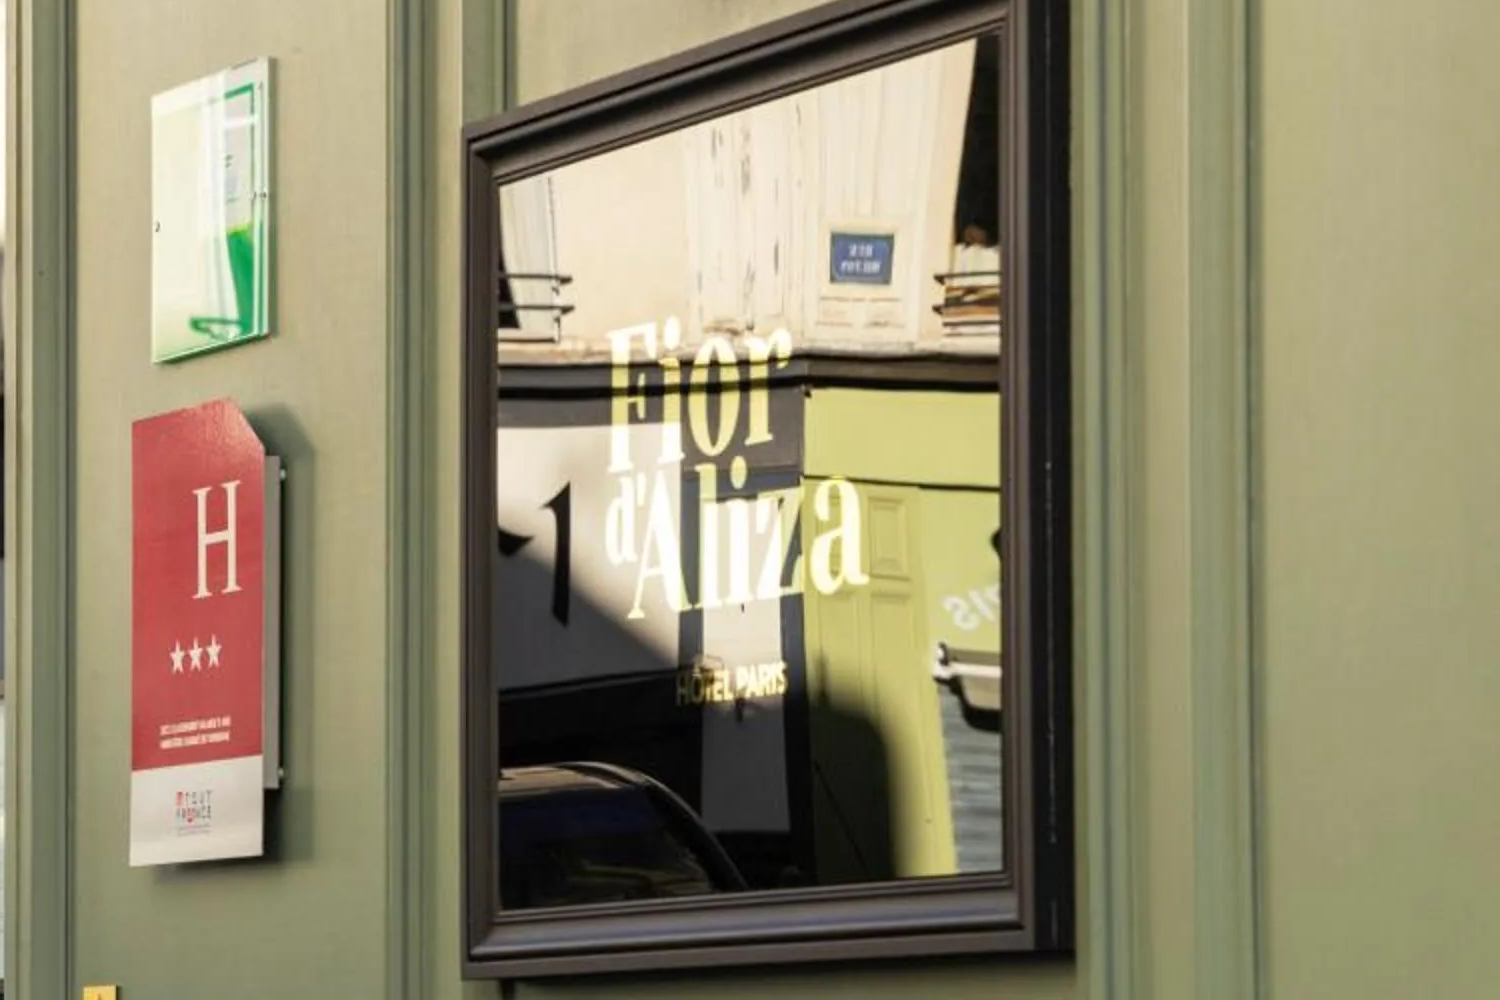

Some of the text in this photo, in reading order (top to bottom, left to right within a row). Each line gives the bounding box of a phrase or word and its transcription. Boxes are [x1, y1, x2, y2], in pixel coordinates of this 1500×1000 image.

[605, 315, 793, 474] Fior
[191, 479, 242, 600] H
[604, 454, 871, 619] d'Aliza
